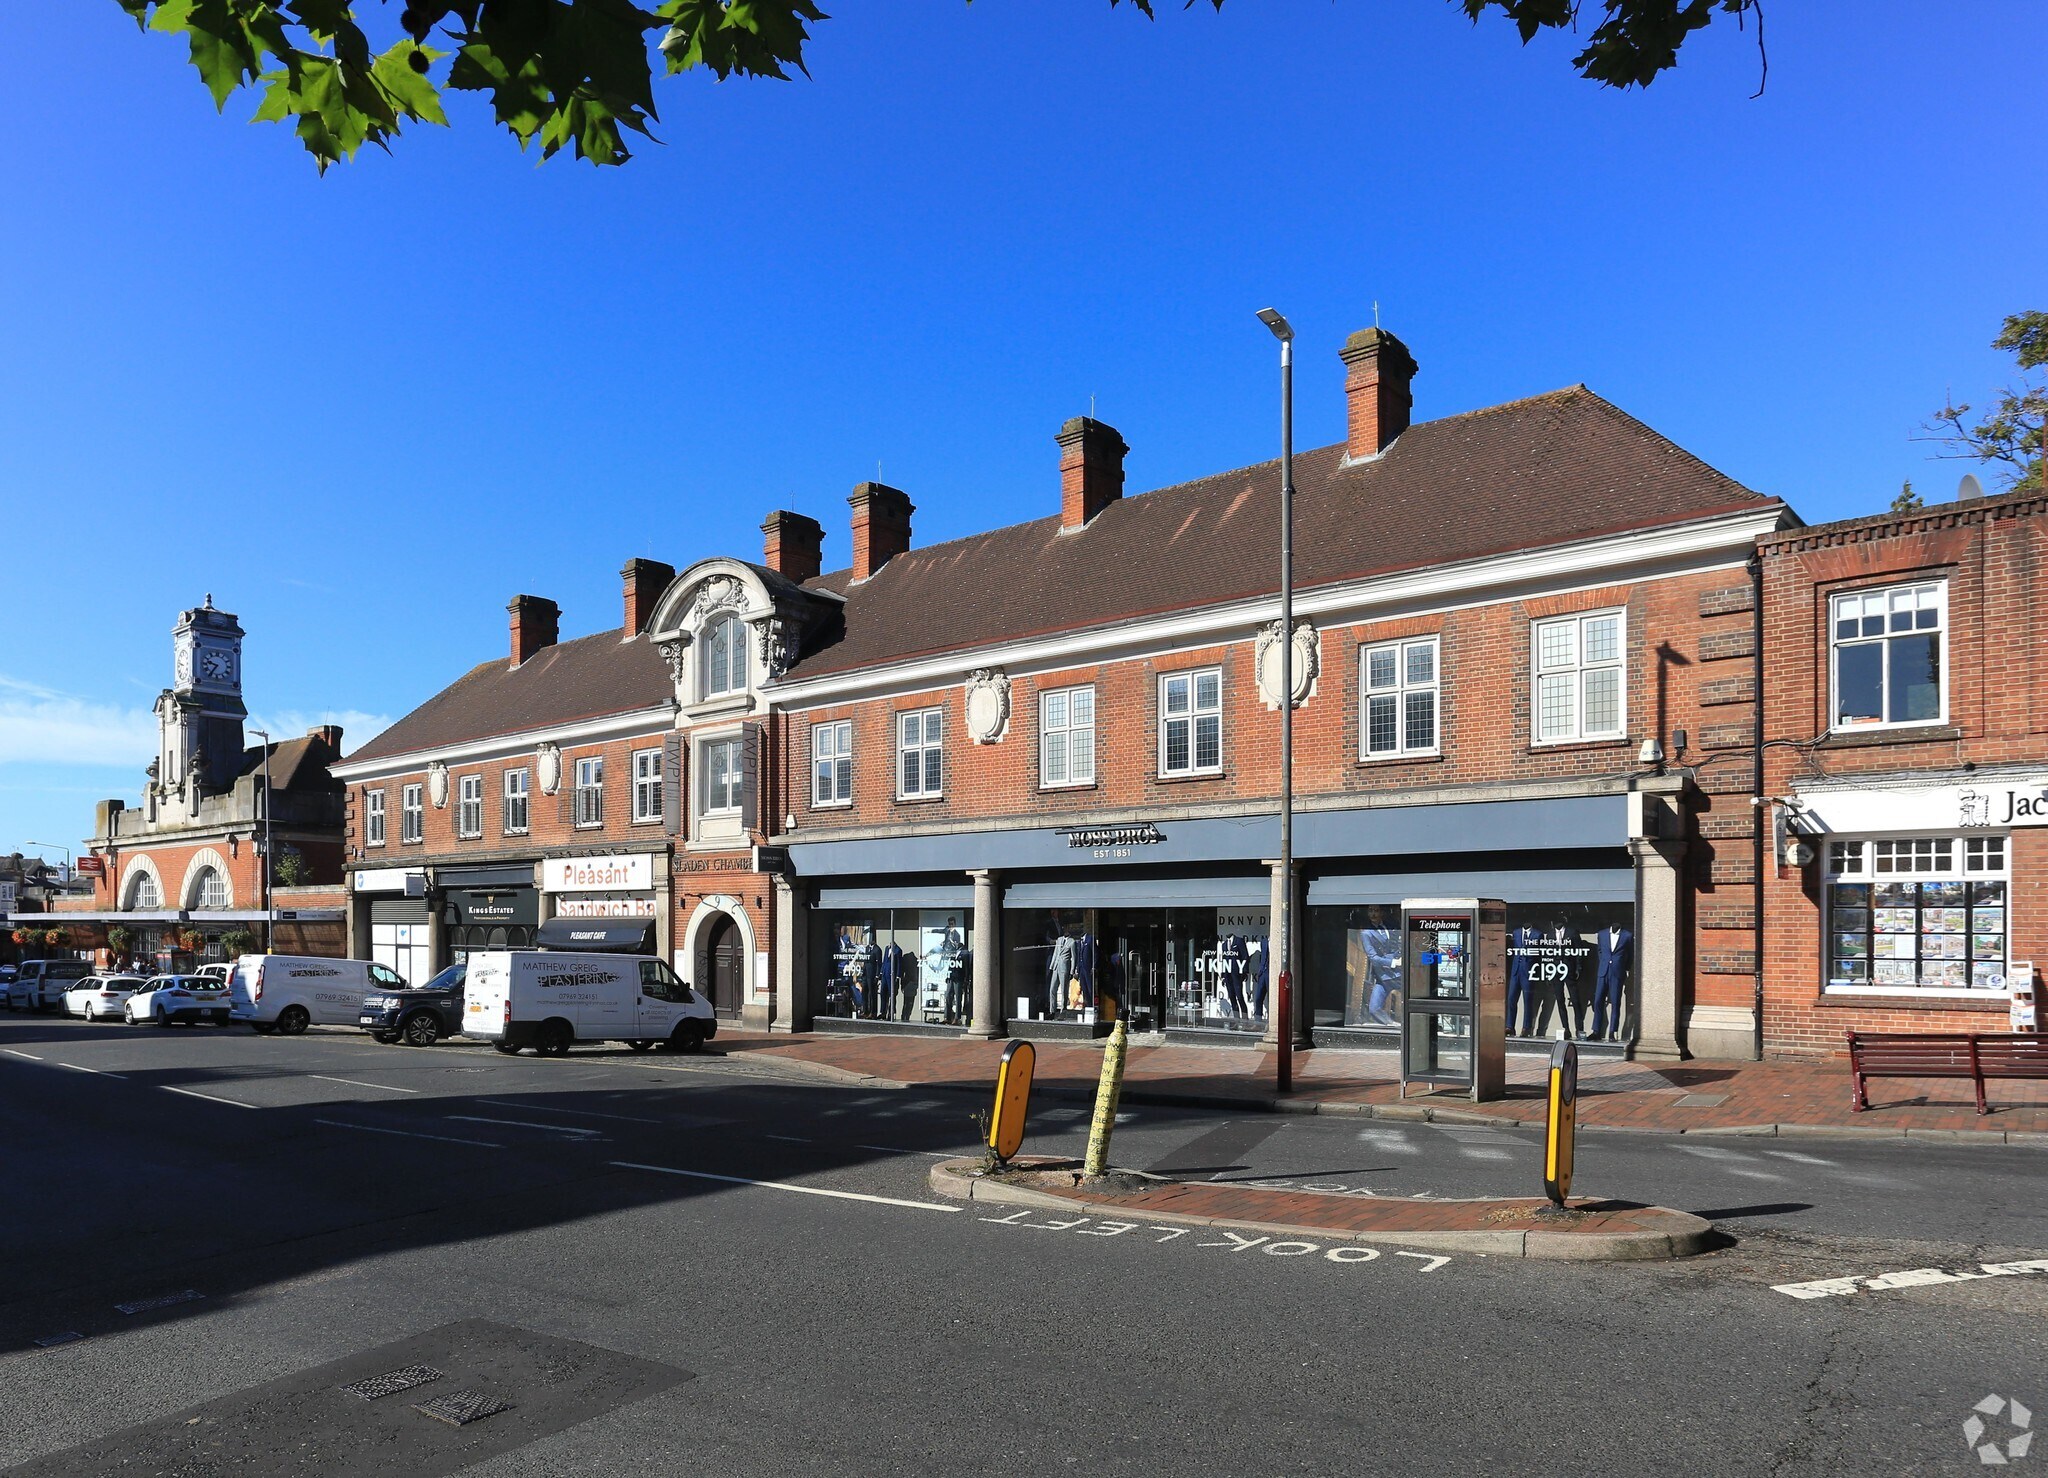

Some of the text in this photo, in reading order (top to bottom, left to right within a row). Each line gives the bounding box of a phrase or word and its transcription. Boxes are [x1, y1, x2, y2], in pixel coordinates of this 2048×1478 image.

[1068, 830, 1112, 848] MOSS
[1093, 849, 1131, 858] EST 1851
[564, 865, 628, 885] Pleasant
[560, 898, 629, 917] Sandwich
[1219, 916, 1253, 925] DKNY
[1420, 920, 1461, 931] Telephone
[570, 931, 606, 940] PLEASANT CAFE
[1507, 948, 1590, 956] STRETCH SUIT
[522, 962, 598, 973] MATTHEW GREIG
[1195, 958, 1247, 974] DKNY
[1528, 962, 1569, 981] £199
[977, 1209, 1452, 1273] LOOK LEFT
